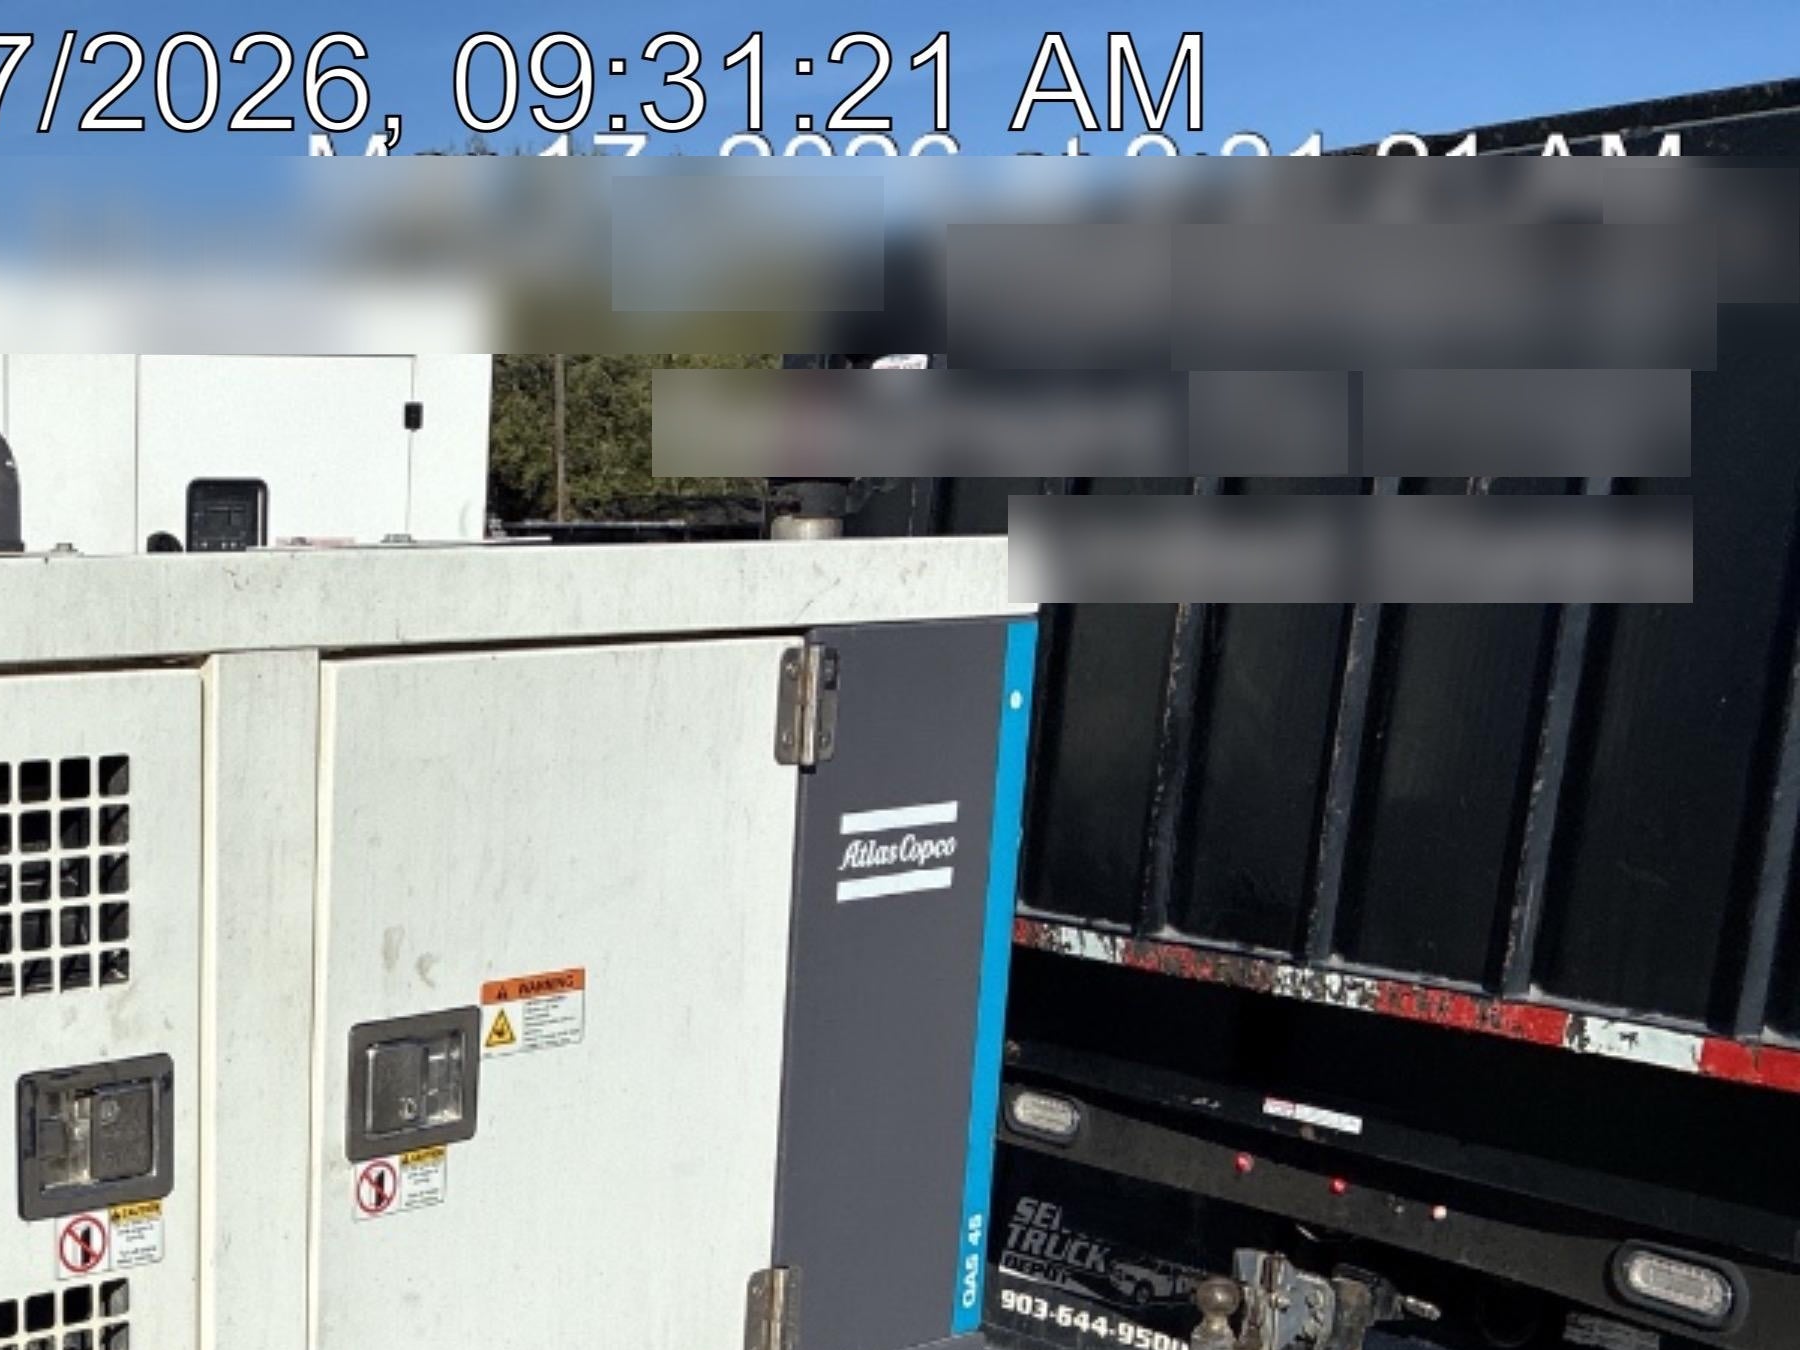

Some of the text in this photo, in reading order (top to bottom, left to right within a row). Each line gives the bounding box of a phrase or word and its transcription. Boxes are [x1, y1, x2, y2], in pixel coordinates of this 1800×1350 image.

[837, 833, 957, 870] Atlas Copco
[1007, 1223, 1111, 1273] TRUCK
